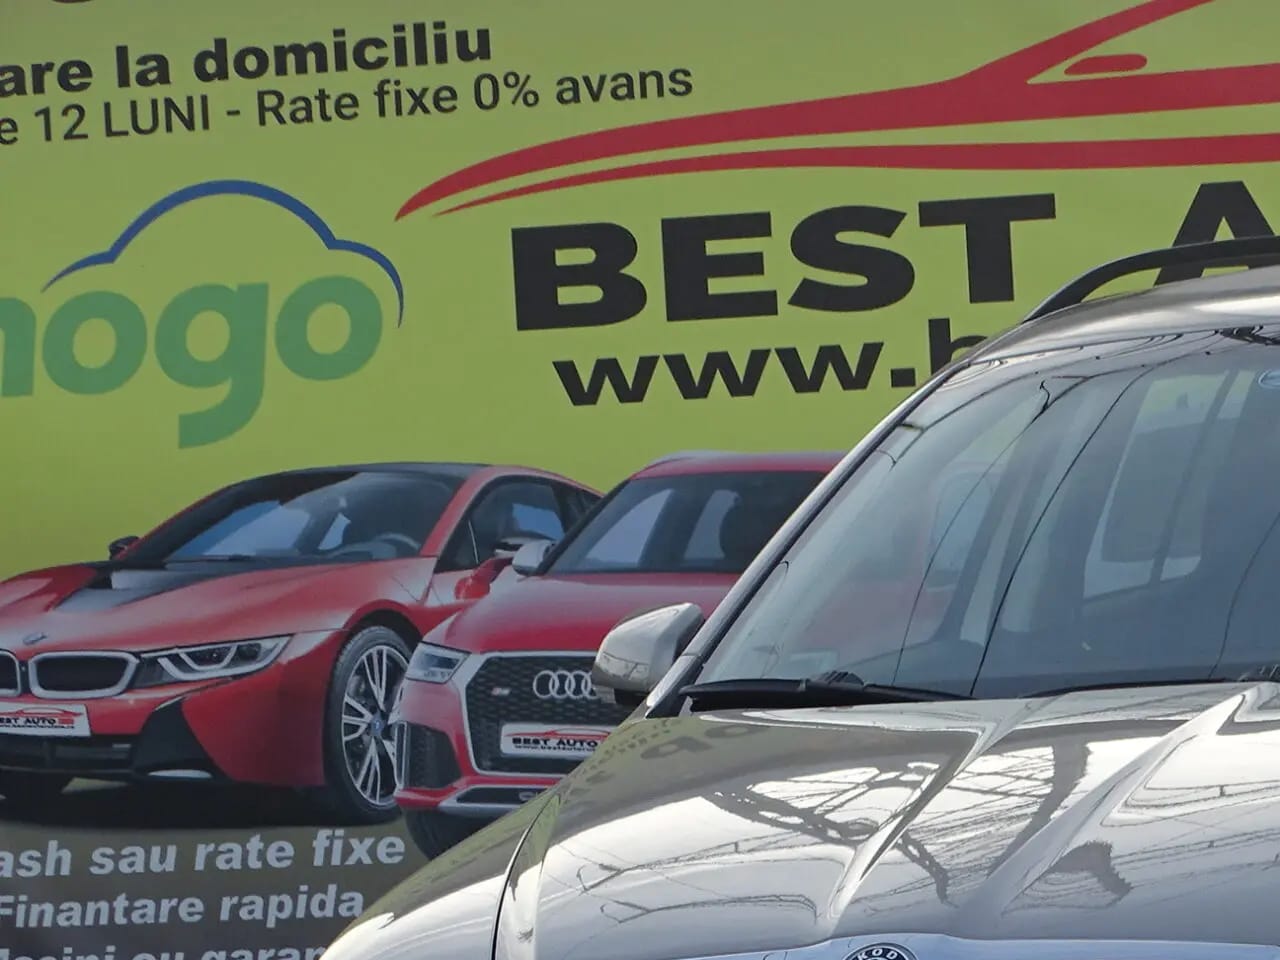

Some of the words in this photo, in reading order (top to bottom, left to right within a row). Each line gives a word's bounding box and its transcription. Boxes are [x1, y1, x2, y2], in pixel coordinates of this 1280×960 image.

[0, 59, 93, 97] are
[115, 45, 171, 88] la
[193, 21, 492, 82] domiciliu
[34, 104, 88, 141] 12
[103, 94, 210, 137] LUNI
[257, 88, 360, 126] Rate
[373, 79, 458, 117] fixe
[473, 71, 540, 110] 0%
[555, 67, 693, 105] avans
[511, 193, 1056, 331] BEST
[556, 738, 598, 748] AUTO
[89, 843, 178, 875] sau
[194, 834, 295, 871] rate
[312, 829, 406, 867] fixe
[219, 884, 364, 929] rapida
